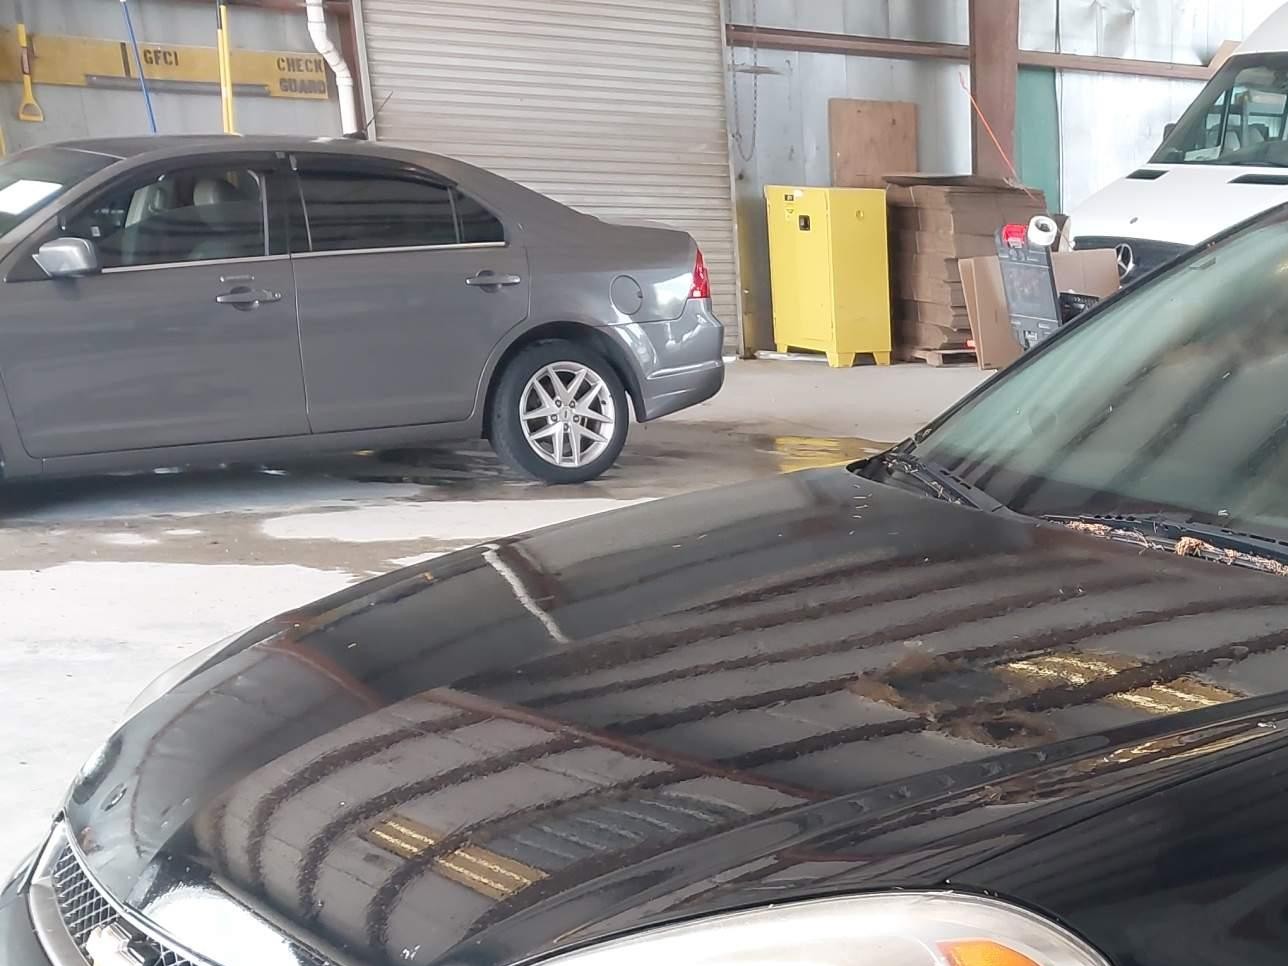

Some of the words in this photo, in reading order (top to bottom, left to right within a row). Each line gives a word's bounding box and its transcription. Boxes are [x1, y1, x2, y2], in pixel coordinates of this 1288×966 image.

[143, 49, 179, 67] GFCI
[276, 56, 325, 74] CHECK
[279, 77, 326, 95] GUARD
